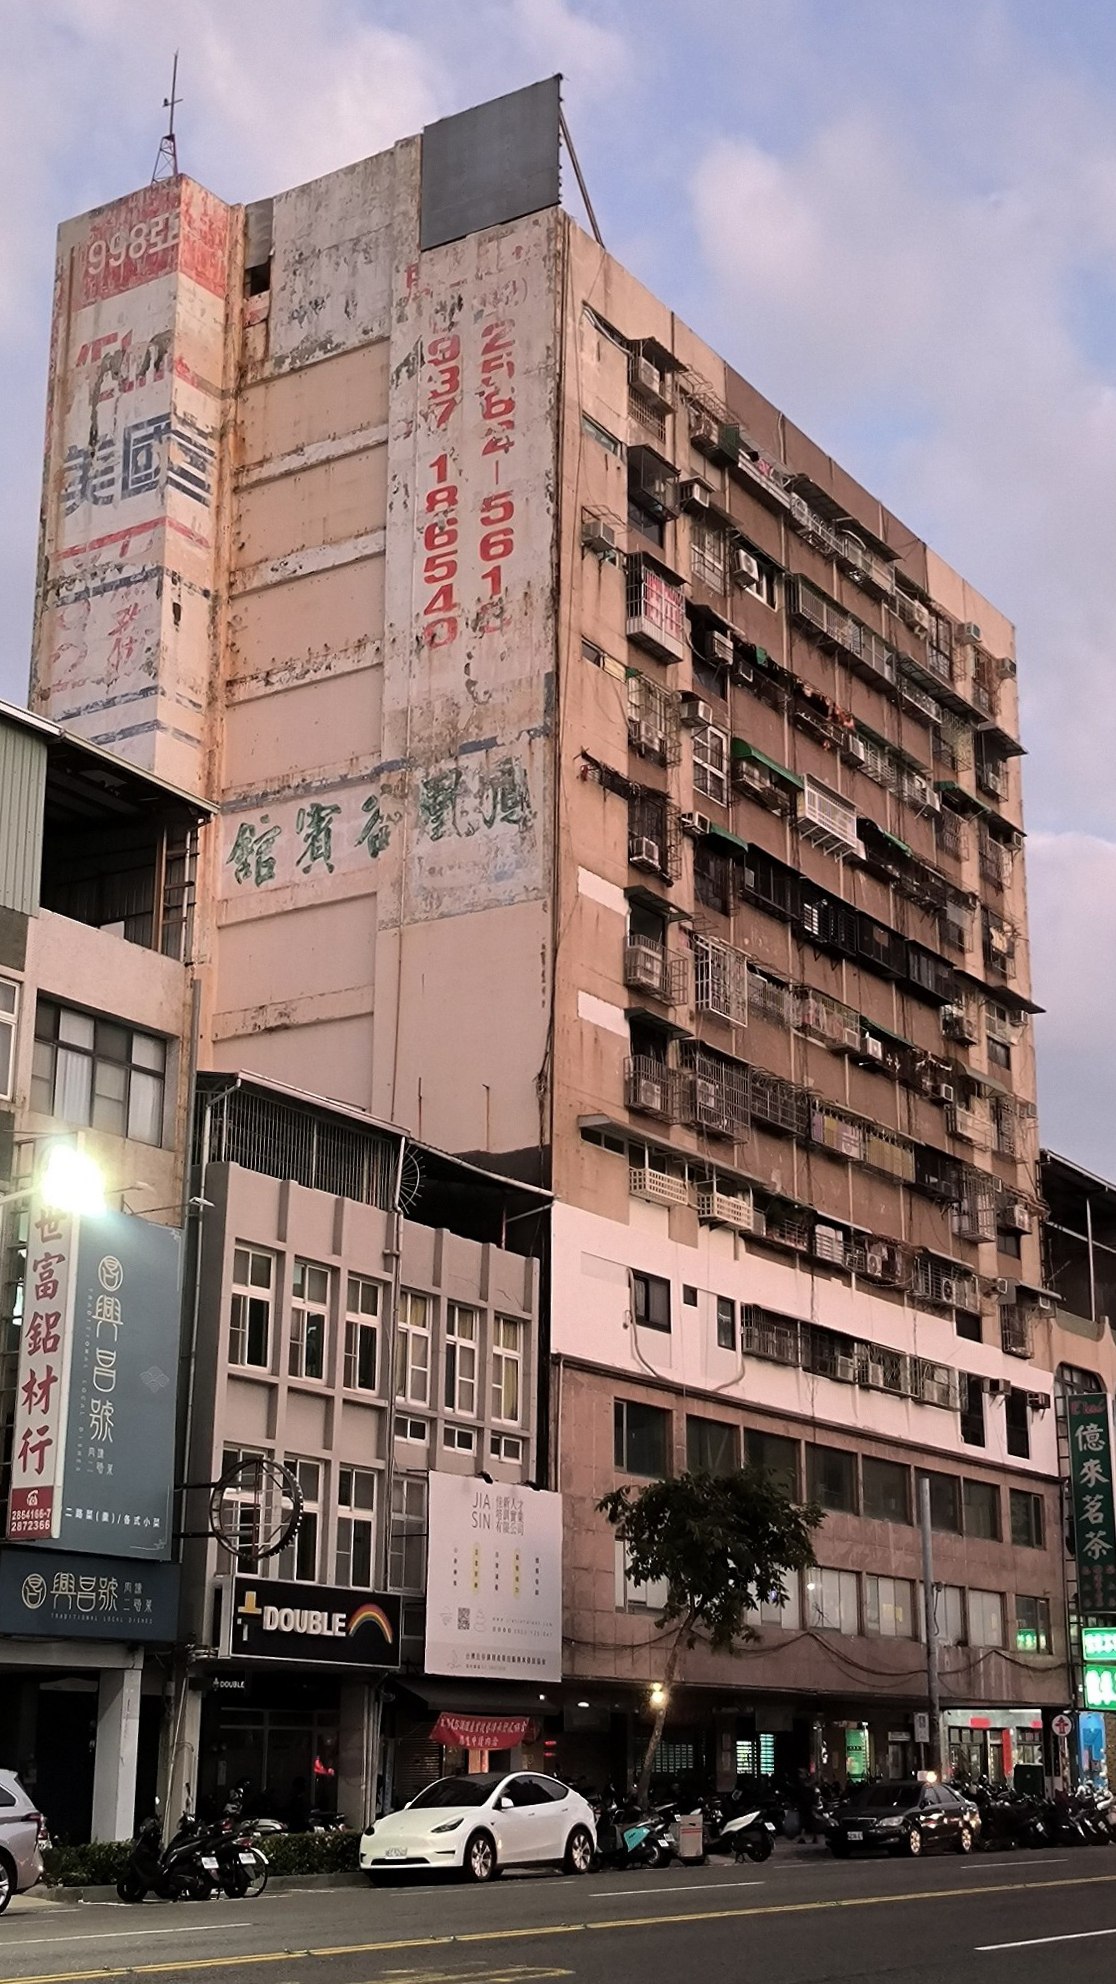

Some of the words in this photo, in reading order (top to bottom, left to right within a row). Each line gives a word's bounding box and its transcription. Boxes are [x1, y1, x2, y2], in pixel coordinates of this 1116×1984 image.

[472, 1492, 491, 1508] JIA
[1075, 1422, 1113, 1561] 億來茗茶
[471, 1511, 491, 1530] SIN
[262, 1605, 347, 1637] DOUBLE
[220, 1680, 245, 1689] DOUBLE
